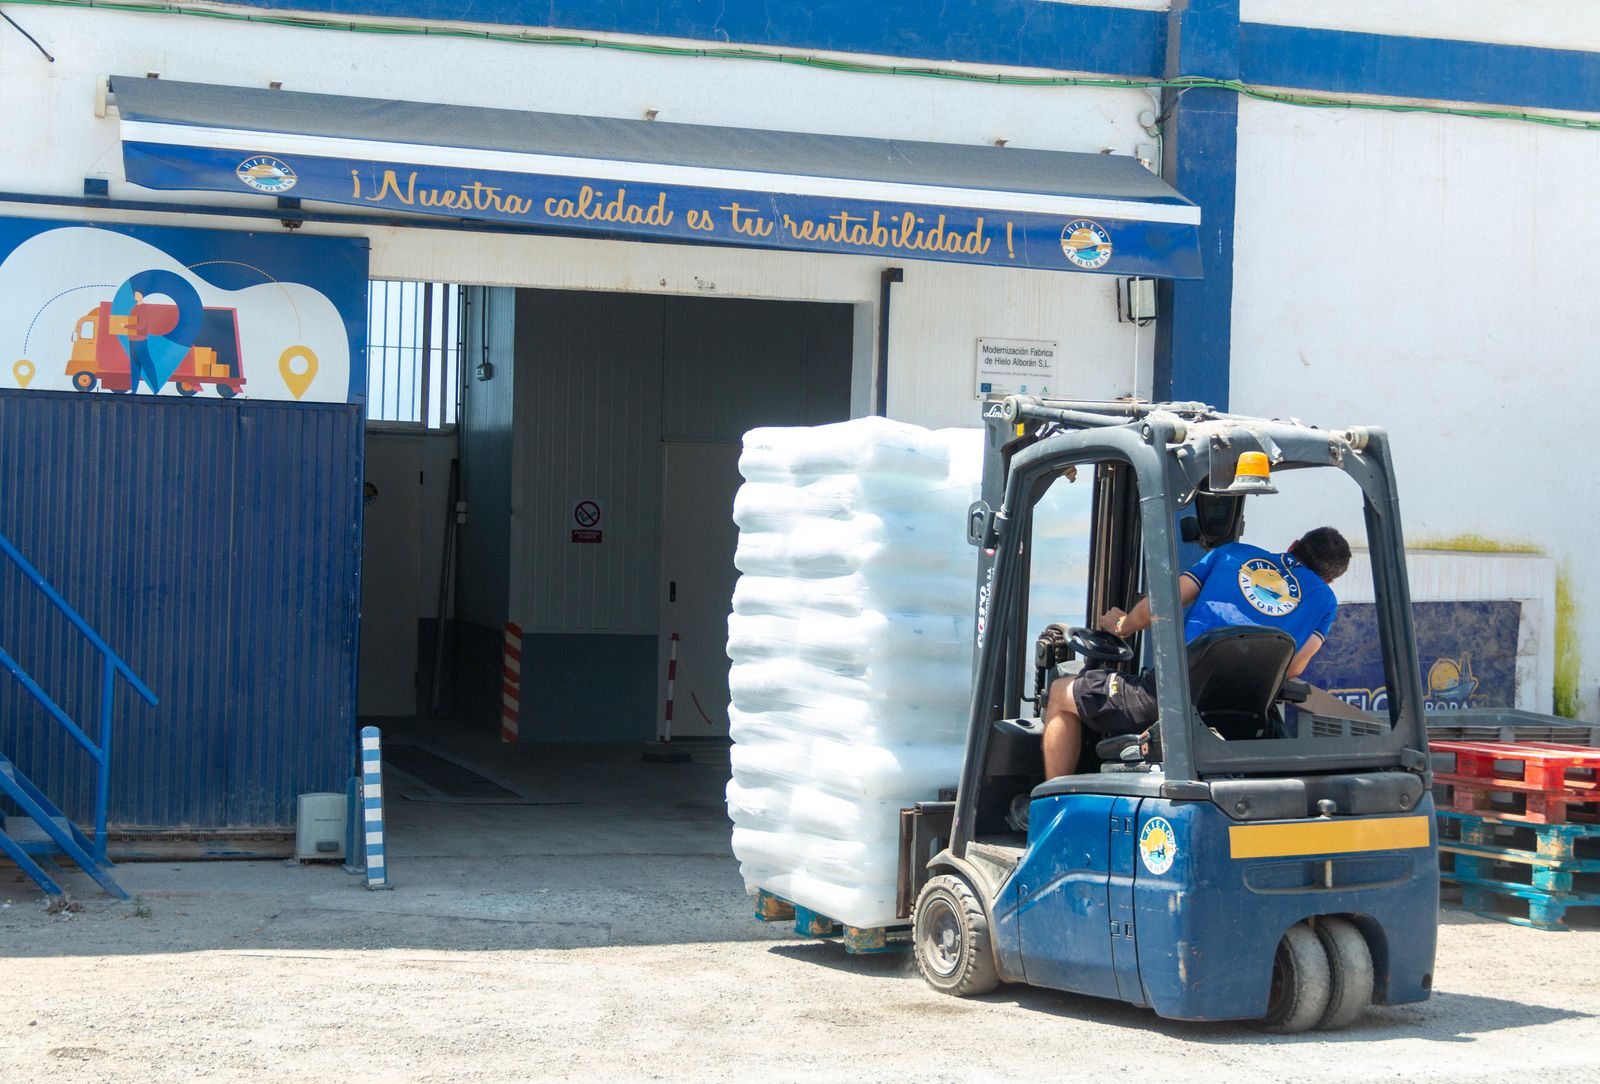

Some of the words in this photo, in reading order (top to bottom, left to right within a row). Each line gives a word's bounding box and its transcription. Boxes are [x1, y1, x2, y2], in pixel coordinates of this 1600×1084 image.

[243, 158, 289, 173] HIELO
[544, 185, 674, 227] calidad
[687, 209, 715, 231] es
[719, 202, 775, 237] tu
[783, 210, 991, 255] rentabilidad
[1066, 221, 1105, 238] HIELO
[982, 345, 1029, 356] Modernización
[1030, 348, 1054, 357] Fabrica
[984, 357, 993, 365] de
[994, 357, 1011, 366] Hielo
[1012, 358, 1037, 367] Alborán
